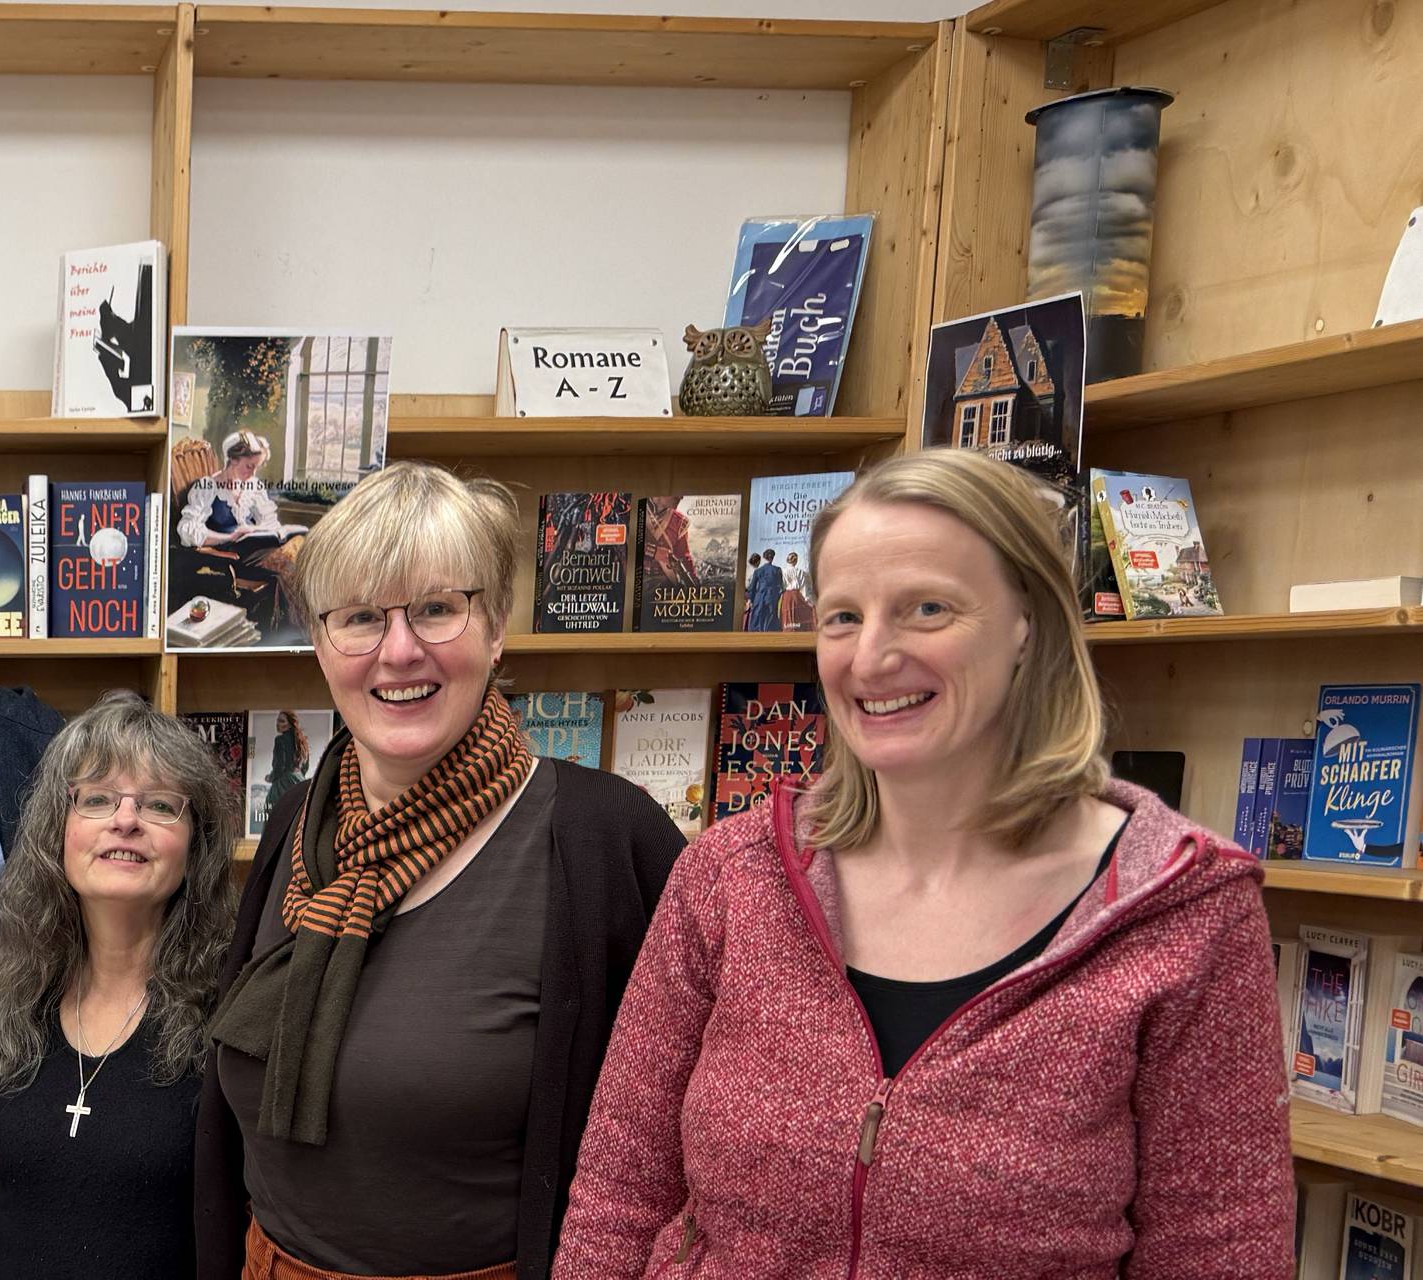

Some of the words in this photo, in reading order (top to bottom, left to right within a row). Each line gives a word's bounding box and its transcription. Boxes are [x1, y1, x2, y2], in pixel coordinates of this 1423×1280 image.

[70, 262, 108, 276] Berichte
[70, 285, 91, 297] über
[69, 307, 96, 318] meine
[69, 328, 92, 339] Frau
[777, 293, 826, 379] Buch
[532, 347, 641, 368] Romane
[555, 377, 579, 398] A
[608, 376, 627, 398] Z
[1013, 447, 1024, 459] zu
[194, 478, 213, 490] Als
[256, 478, 274, 490] Sie
[277, 479, 309, 491] dabei
[61, 490, 87, 501] HANNES
[695, 499, 736, 507] BERNARD
[687, 508, 736, 516] CORNWELL
[31, 499, 47, 564] ZULEIKA
[777, 520, 810, 533] RUH
[562, 550, 611, 567] Bernard
[58, 557, 122, 590] GEHT
[549, 562, 620, 586] Cornwell
[560, 594, 577, 602] DER
[579, 593, 607, 602] LETZTE
[654, 586, 725, 601] SHARPES
[547, 602, 619, 614] SCHILDWALL
[69, 600, 137, 633] NOCH
[565, 621, 600, 629] UHTRED
[1325, 695, 1368, 705] ORLANDO
[1371, 694, 1410, 704] MURRIN
[746, 700, 807, 720] DAN
[558, 719, 588, 727] HYNES
[622, 713, 657, 722] ANNE
[660, 712, 704, 723] JACOBS
[637, 738, 686, 751] DORF
[727, 730, 817, 756] JONES
[1338, 740, 1367, 763] MIT
[629, 753, 691, 767] LADEN
[727, 761, 816, 782] ESSEX
[1320, 759, 1402, 785] SCHARFER
[1324, 785, 1395, 819] Klinge
[1306, 931, 1326, 943] LUCY
[1329, 935, 1360, 948] CLARKE
[1311, 967, 1345, 997] THE
[1304, 998, 1344, 1024] HIKE
